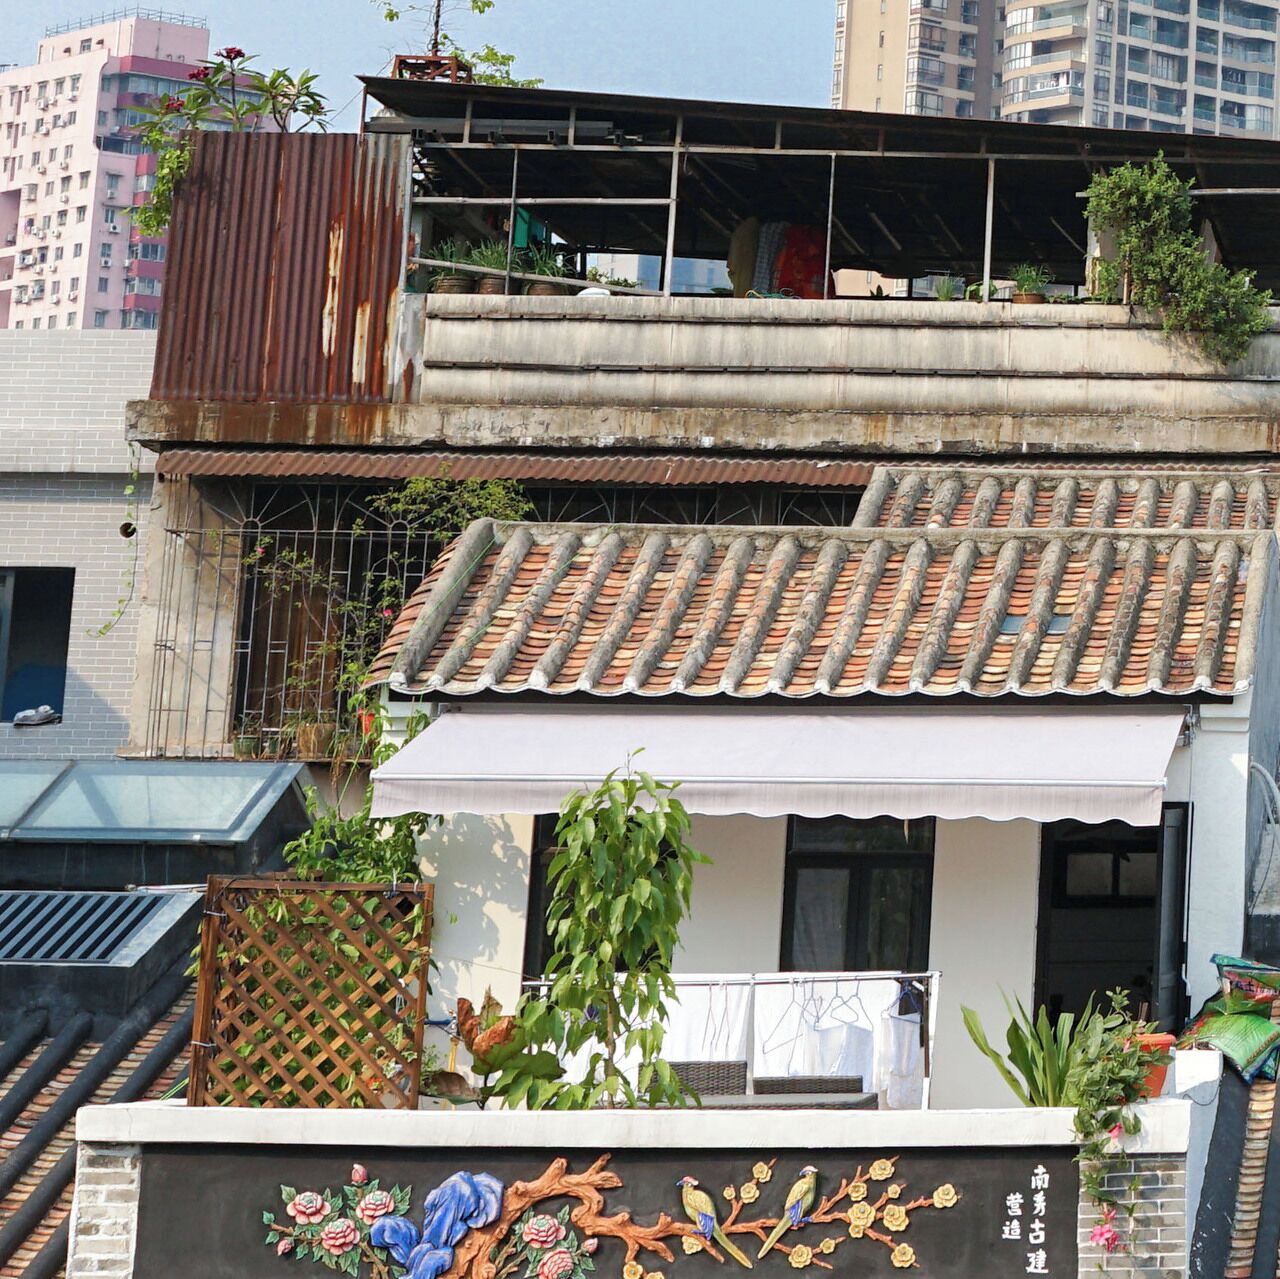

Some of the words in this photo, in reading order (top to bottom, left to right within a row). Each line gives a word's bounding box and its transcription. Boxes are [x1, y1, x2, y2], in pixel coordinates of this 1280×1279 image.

[1001, 1191, 1025, 1240] 营造
[1025, 1164, 1050, 1274] 南秀古建
